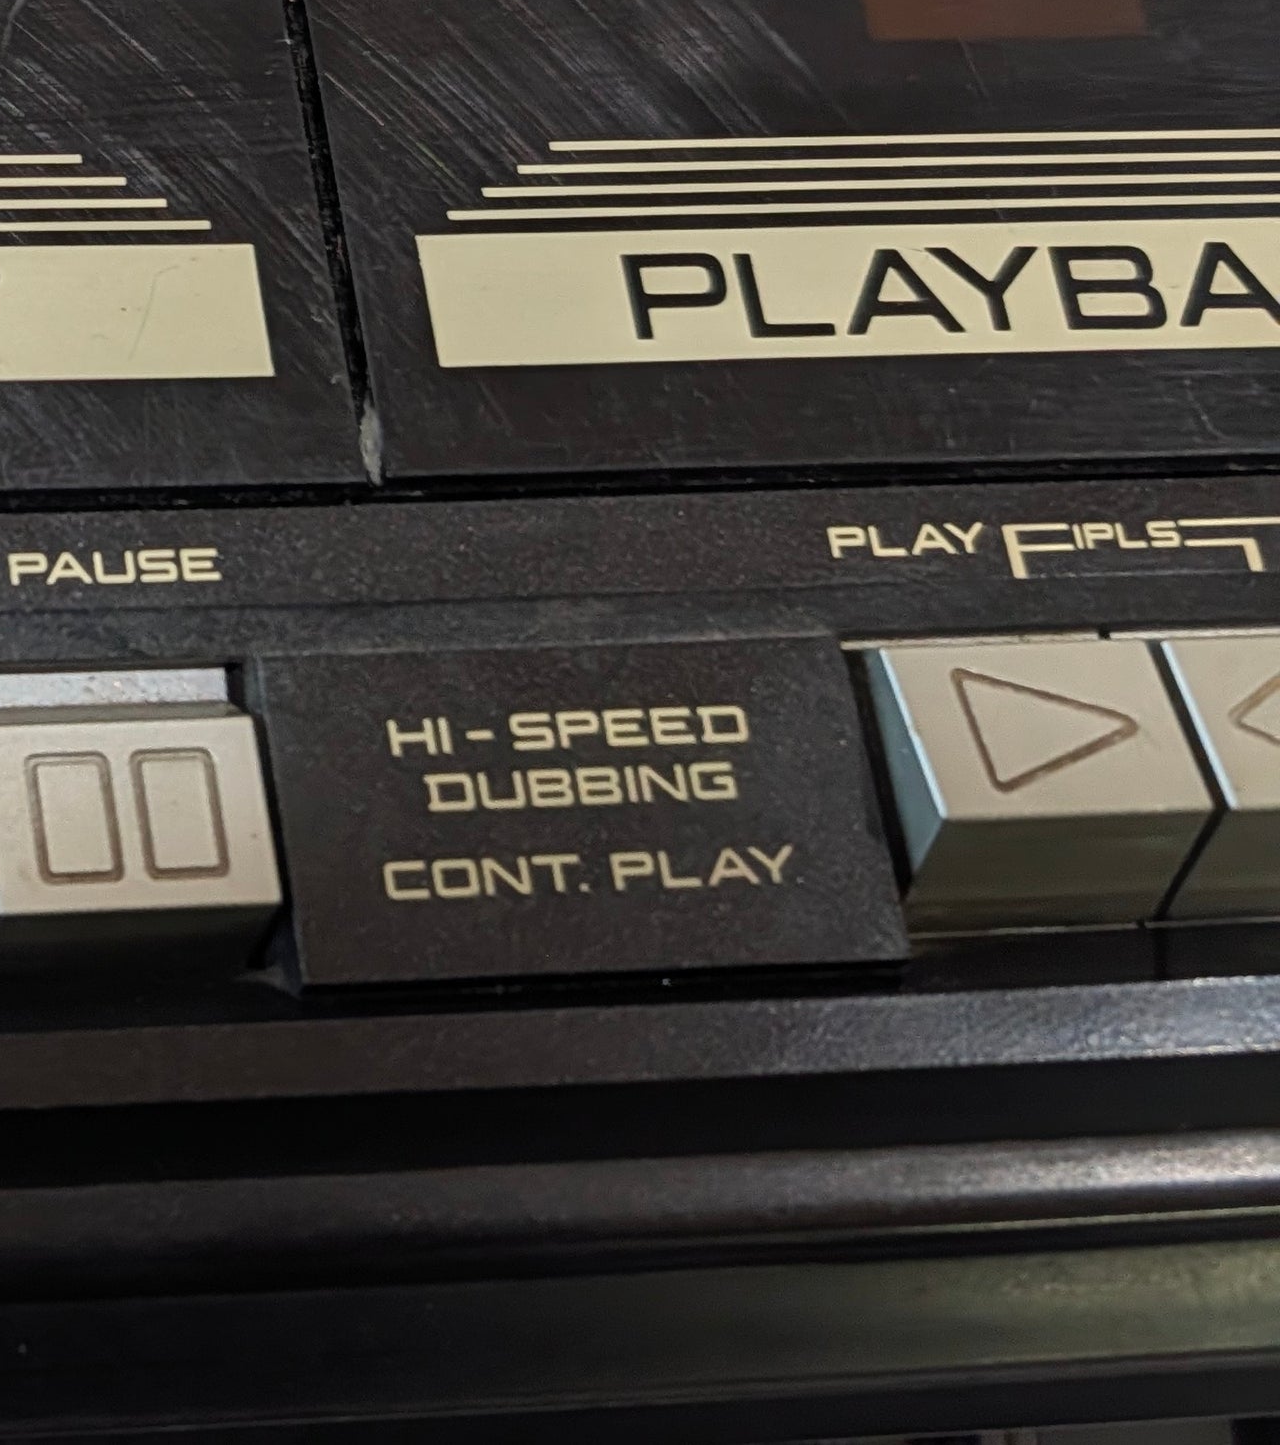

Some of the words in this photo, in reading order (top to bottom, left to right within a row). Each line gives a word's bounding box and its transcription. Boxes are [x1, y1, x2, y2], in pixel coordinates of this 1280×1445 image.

[620, 241, 1280, 340] PLAYBA
[826, 521, 984, 558] PLAY
[7, 548, 223, 587] PAUSE
[423, 761, 738, 812] DUBBING
[383, 853, 590, 901] CONT.
[609, 845, 793, 892] PLAY
